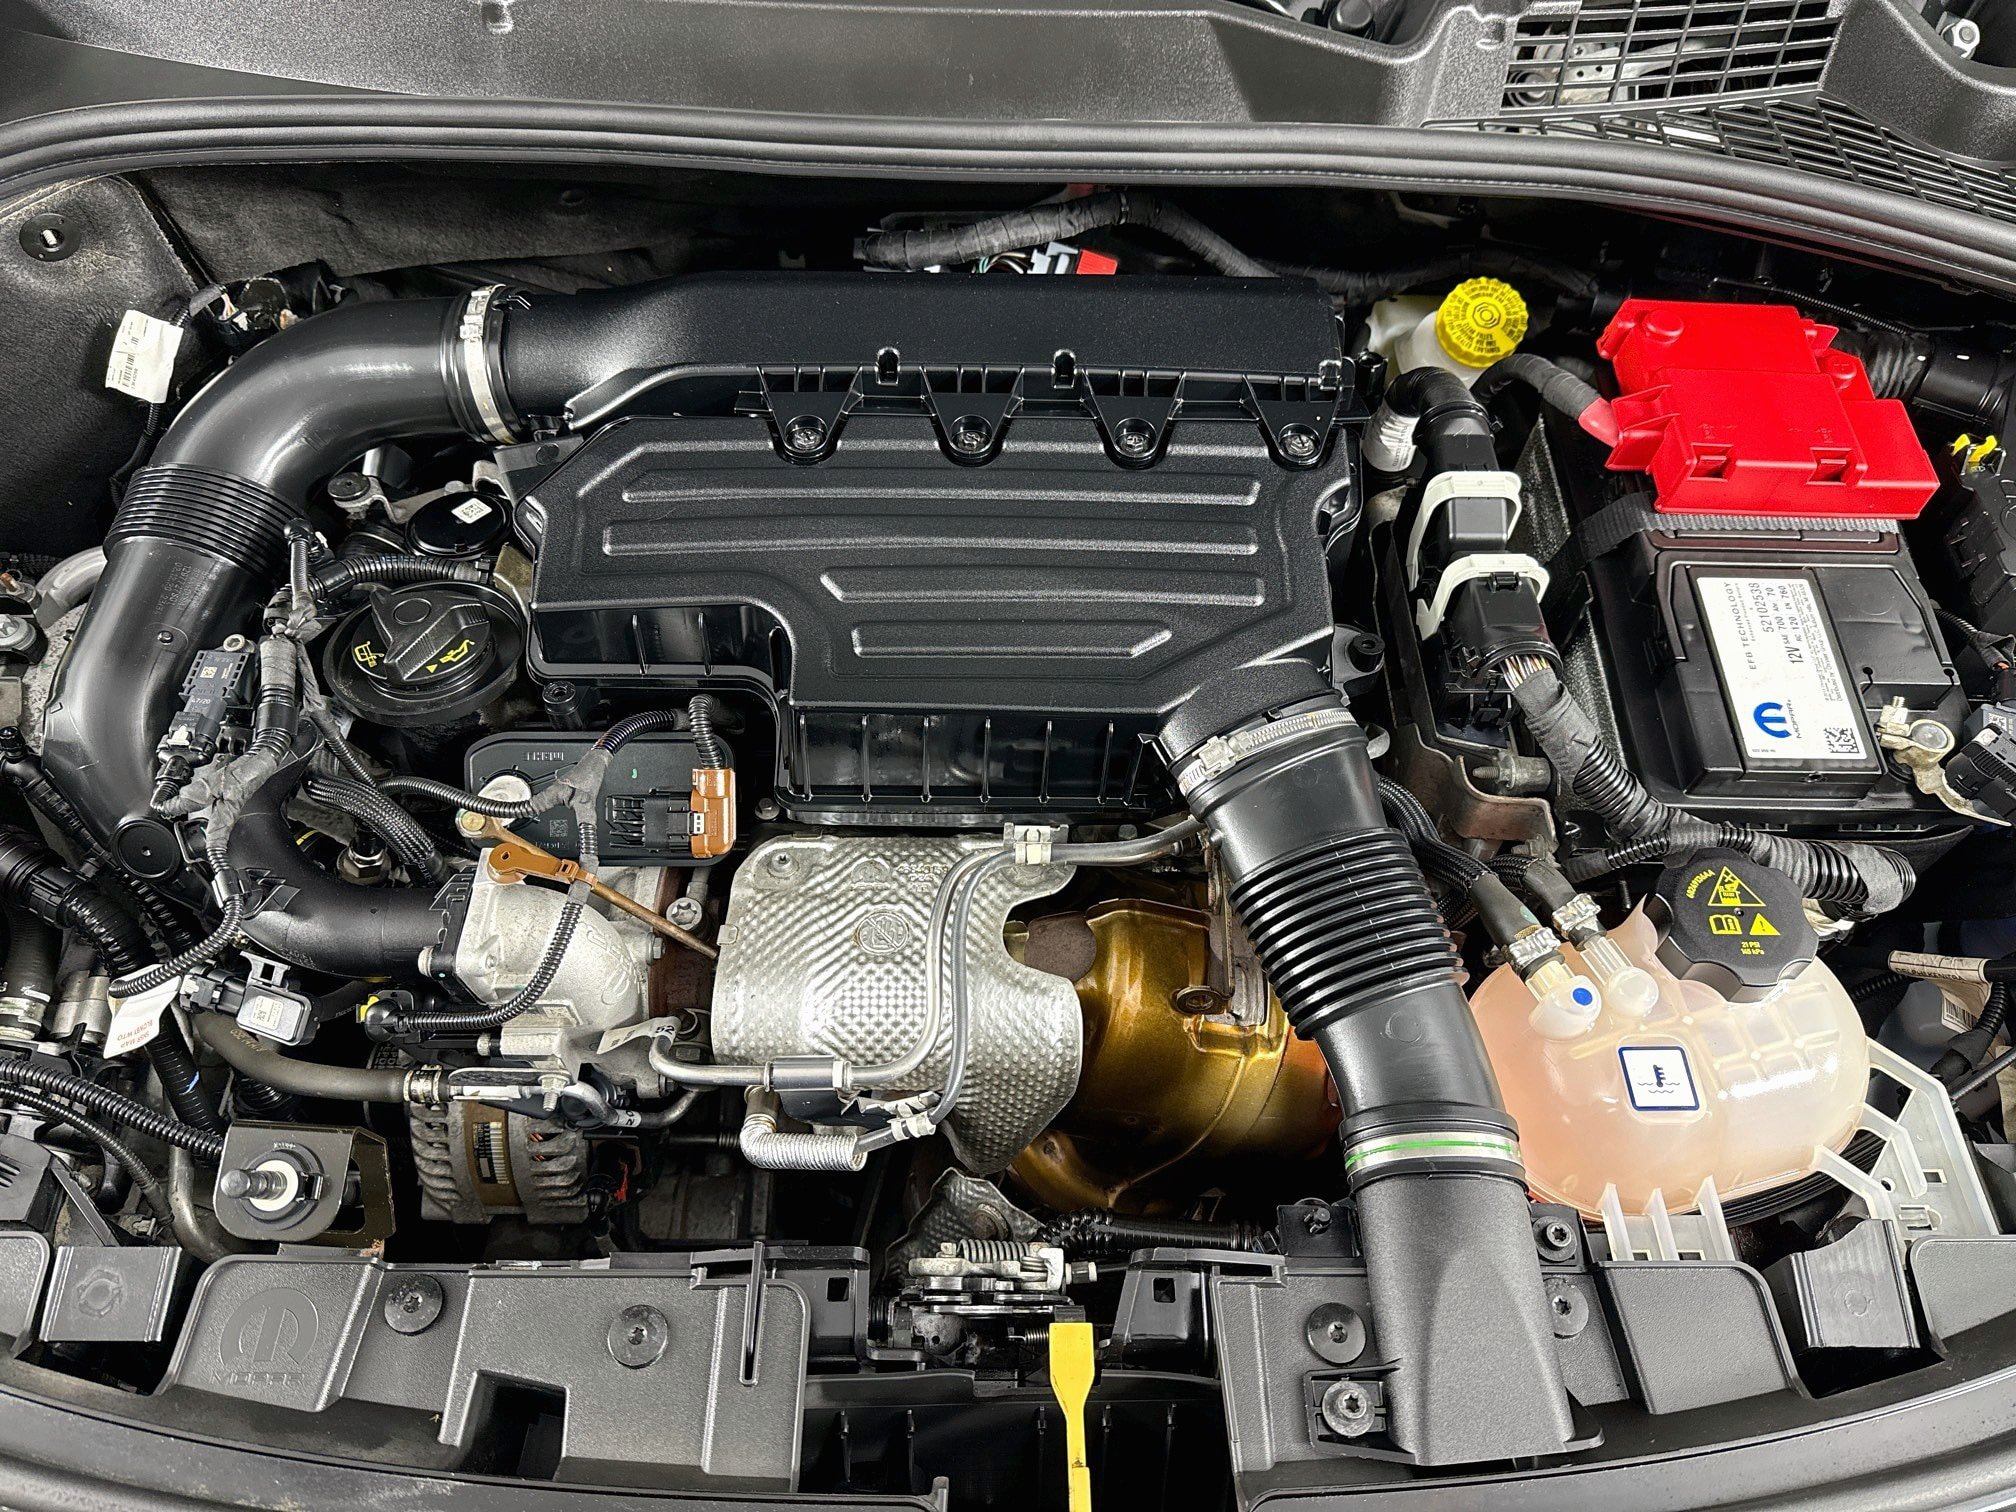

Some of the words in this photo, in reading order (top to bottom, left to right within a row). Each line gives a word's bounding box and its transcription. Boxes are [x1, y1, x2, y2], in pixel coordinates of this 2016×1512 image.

[1764, 587, 1775, 596] 70
[1777, 585, 1789, 598] 760
[1747, 582, 1774, 632] 52102538
[1723, 582, 1749, 647] TECHNOLOGY
[1774, 616, 1786, 630] 700
[1788, 616, 1799, 629] 120
[1781, 634, 1790, 644] SAE
[1745, 651, 1756, 669] EFB
[1784, 646, 1803, 663] 12V
[1786, 702, 1802, 738] MOPAR
[655, 1025, 676, 1035] 52
